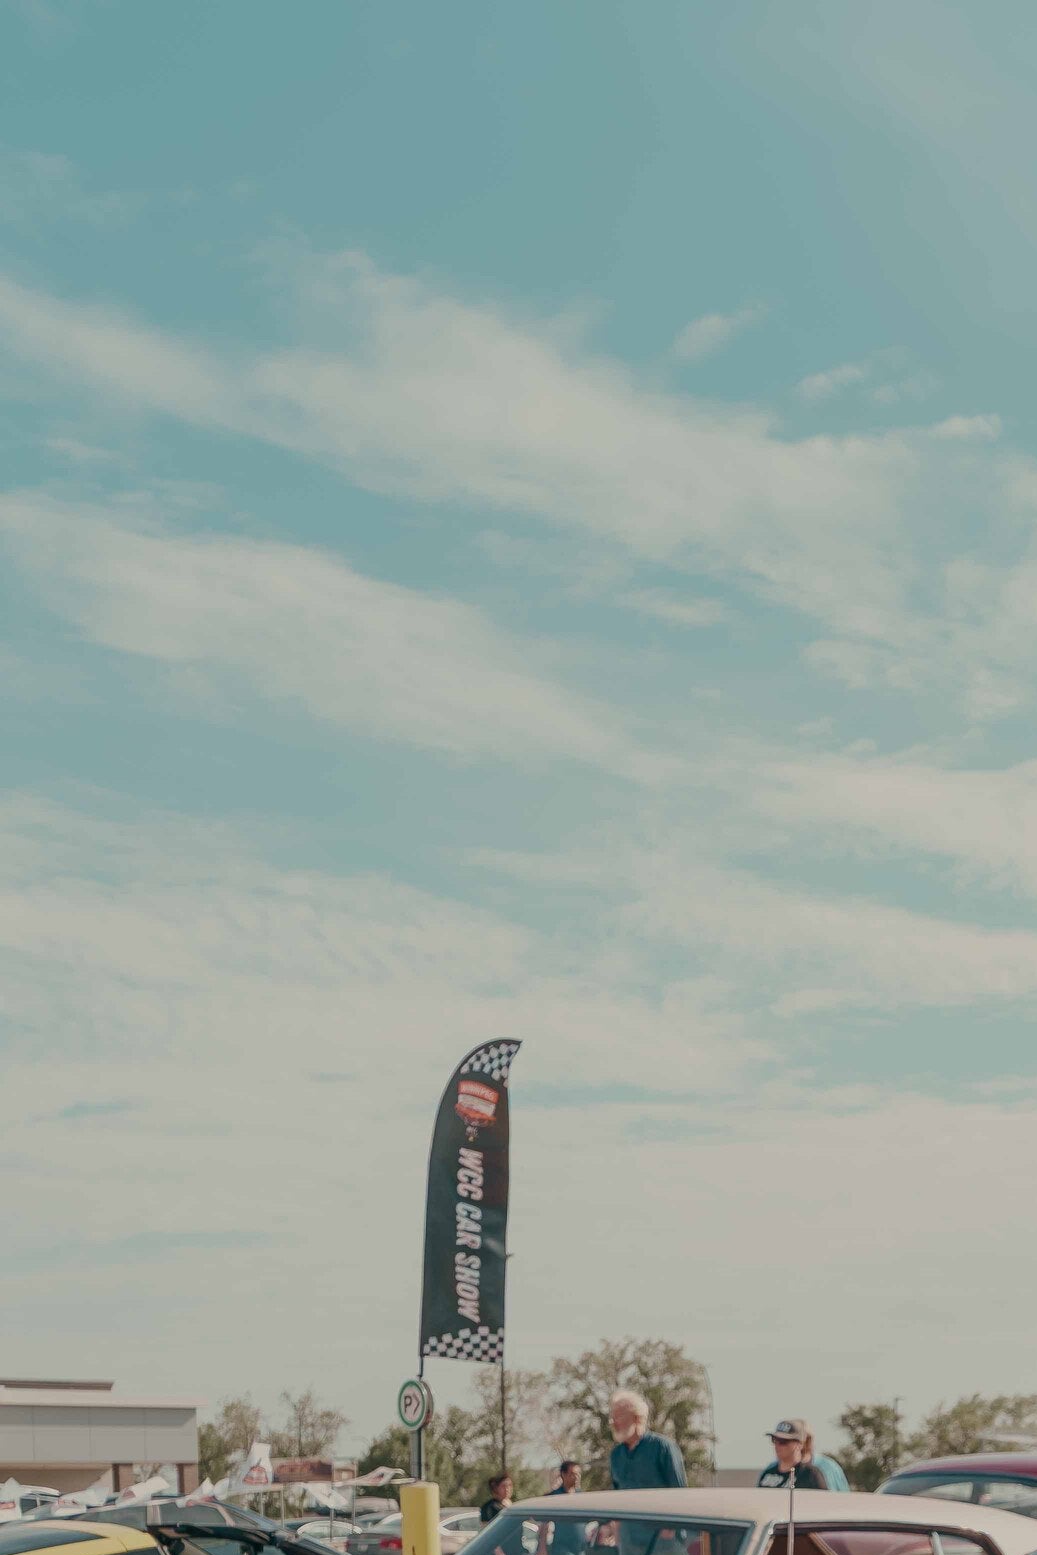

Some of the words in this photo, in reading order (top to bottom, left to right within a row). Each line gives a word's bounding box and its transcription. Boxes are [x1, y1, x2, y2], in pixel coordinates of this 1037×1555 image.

[457, 1146, 484, 1201] WCC
[455, 1201, 482, 1250] CAR
[454, 1251, 482, 1325] SHOW
